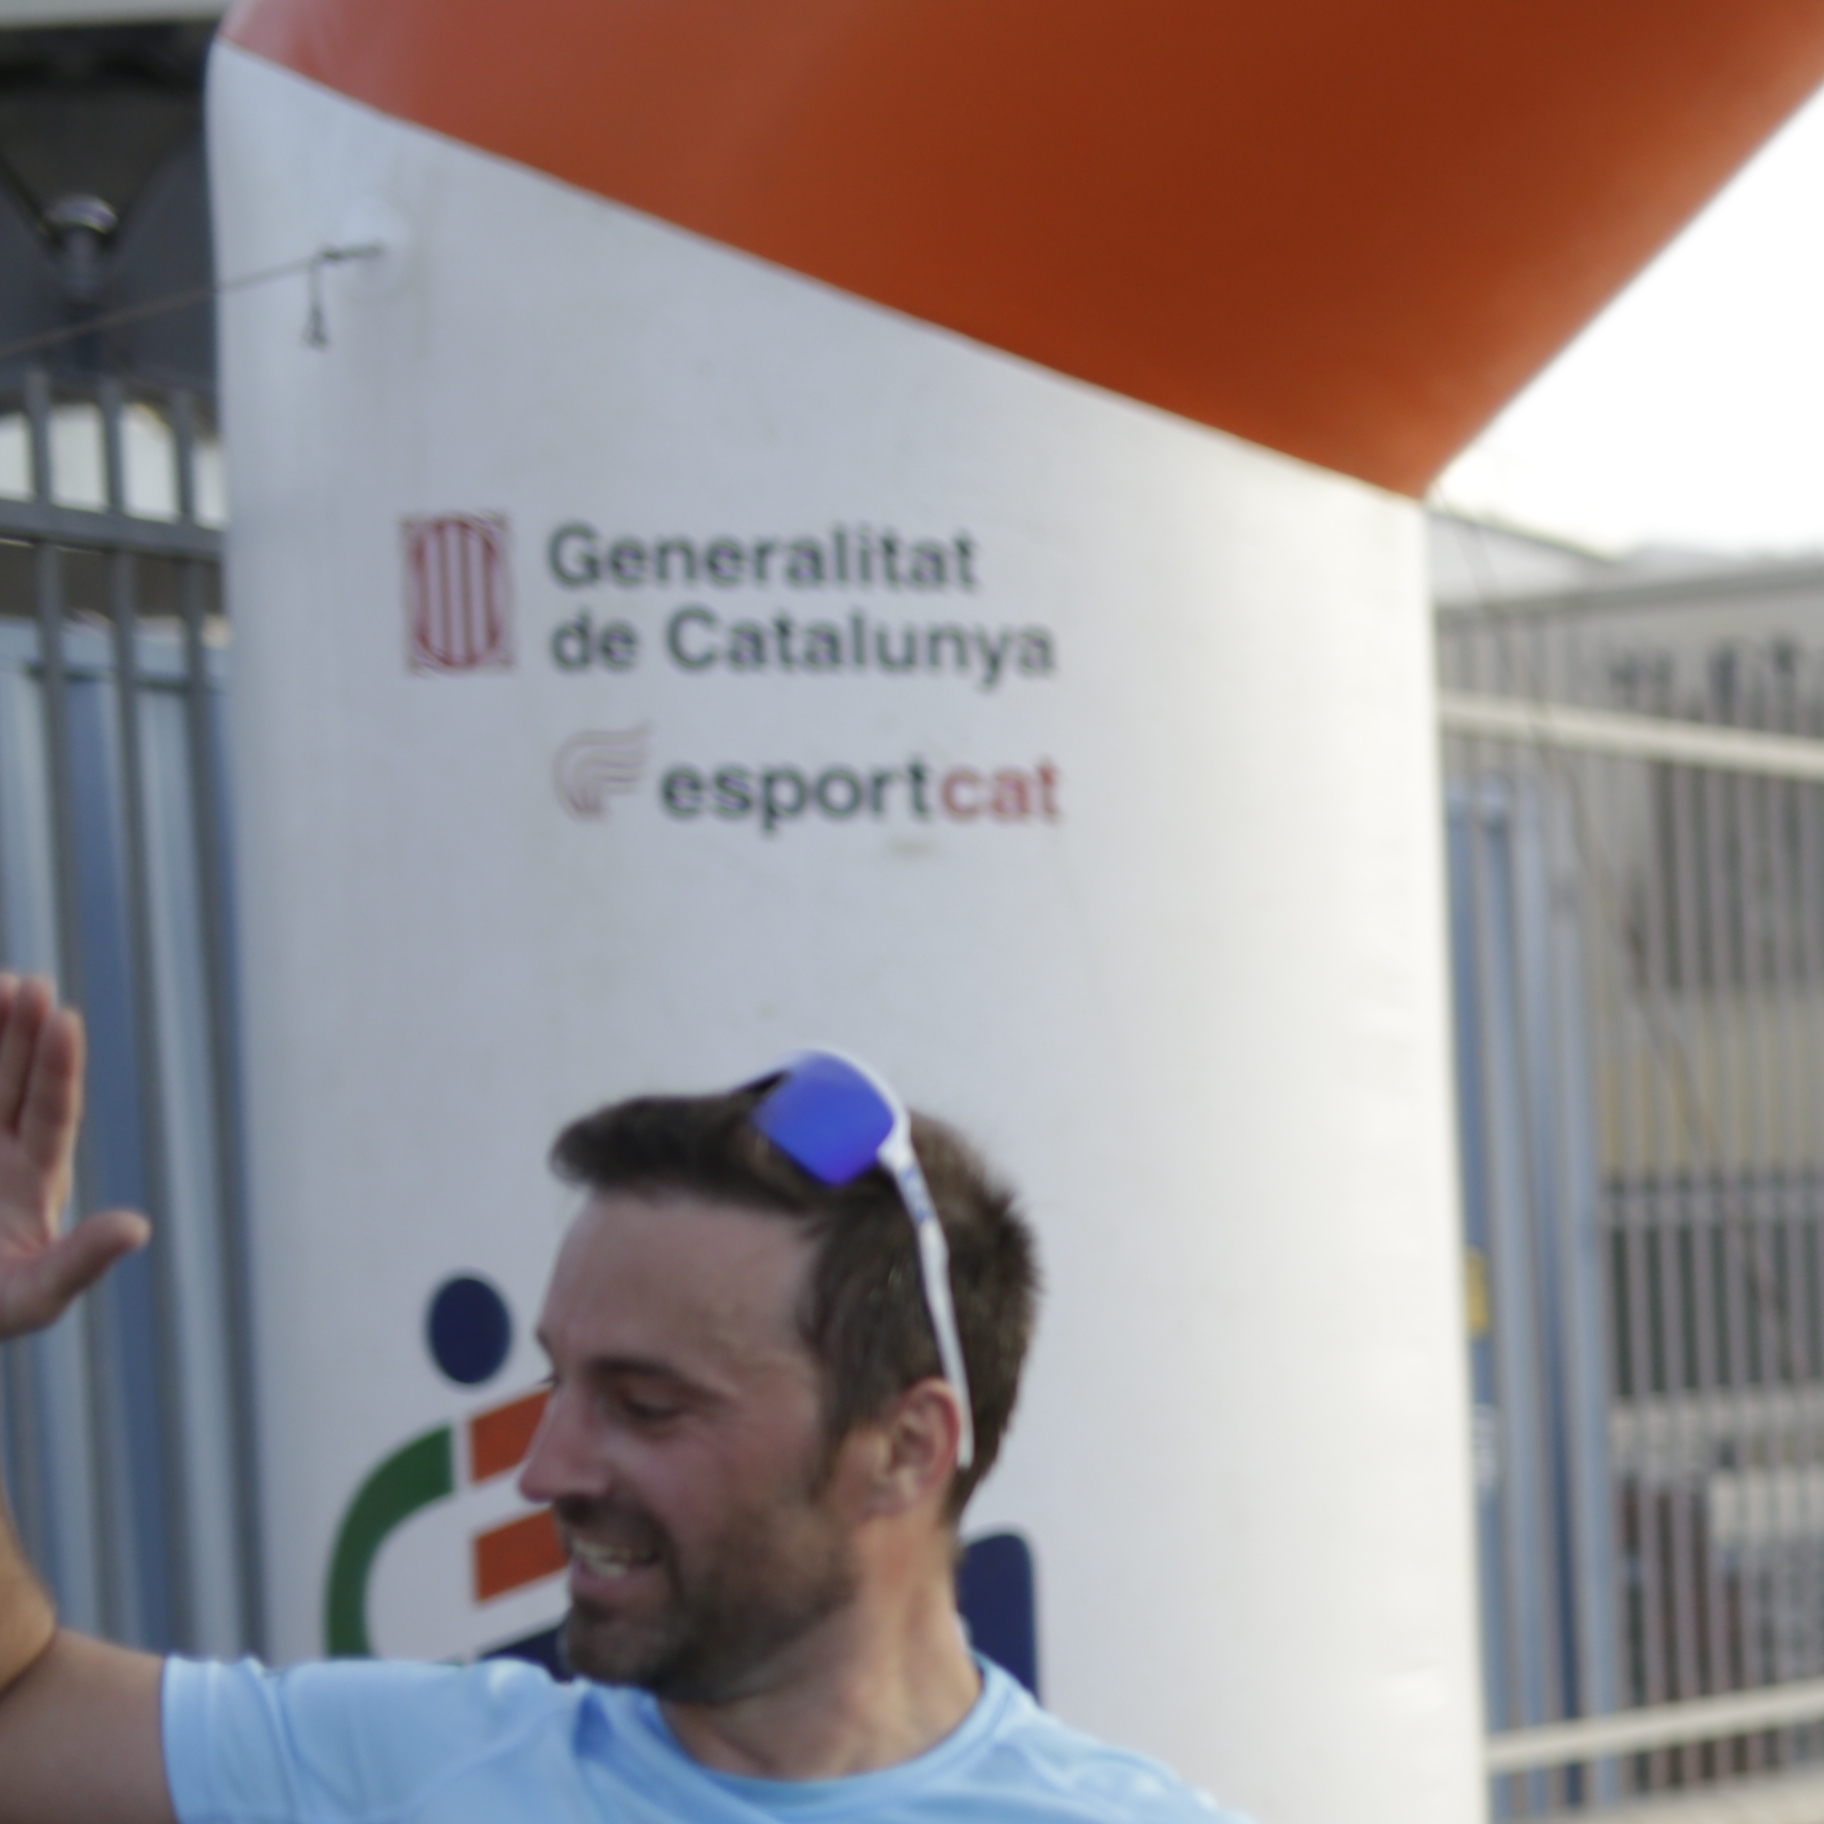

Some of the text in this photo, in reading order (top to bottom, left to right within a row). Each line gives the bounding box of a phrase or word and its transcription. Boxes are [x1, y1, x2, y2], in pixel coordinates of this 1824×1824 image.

[548, 522, 976, 591] Generalitat
[550, 606, 1055, 691] de Catalunya
[661, 758, 1061, 837] esportcat
